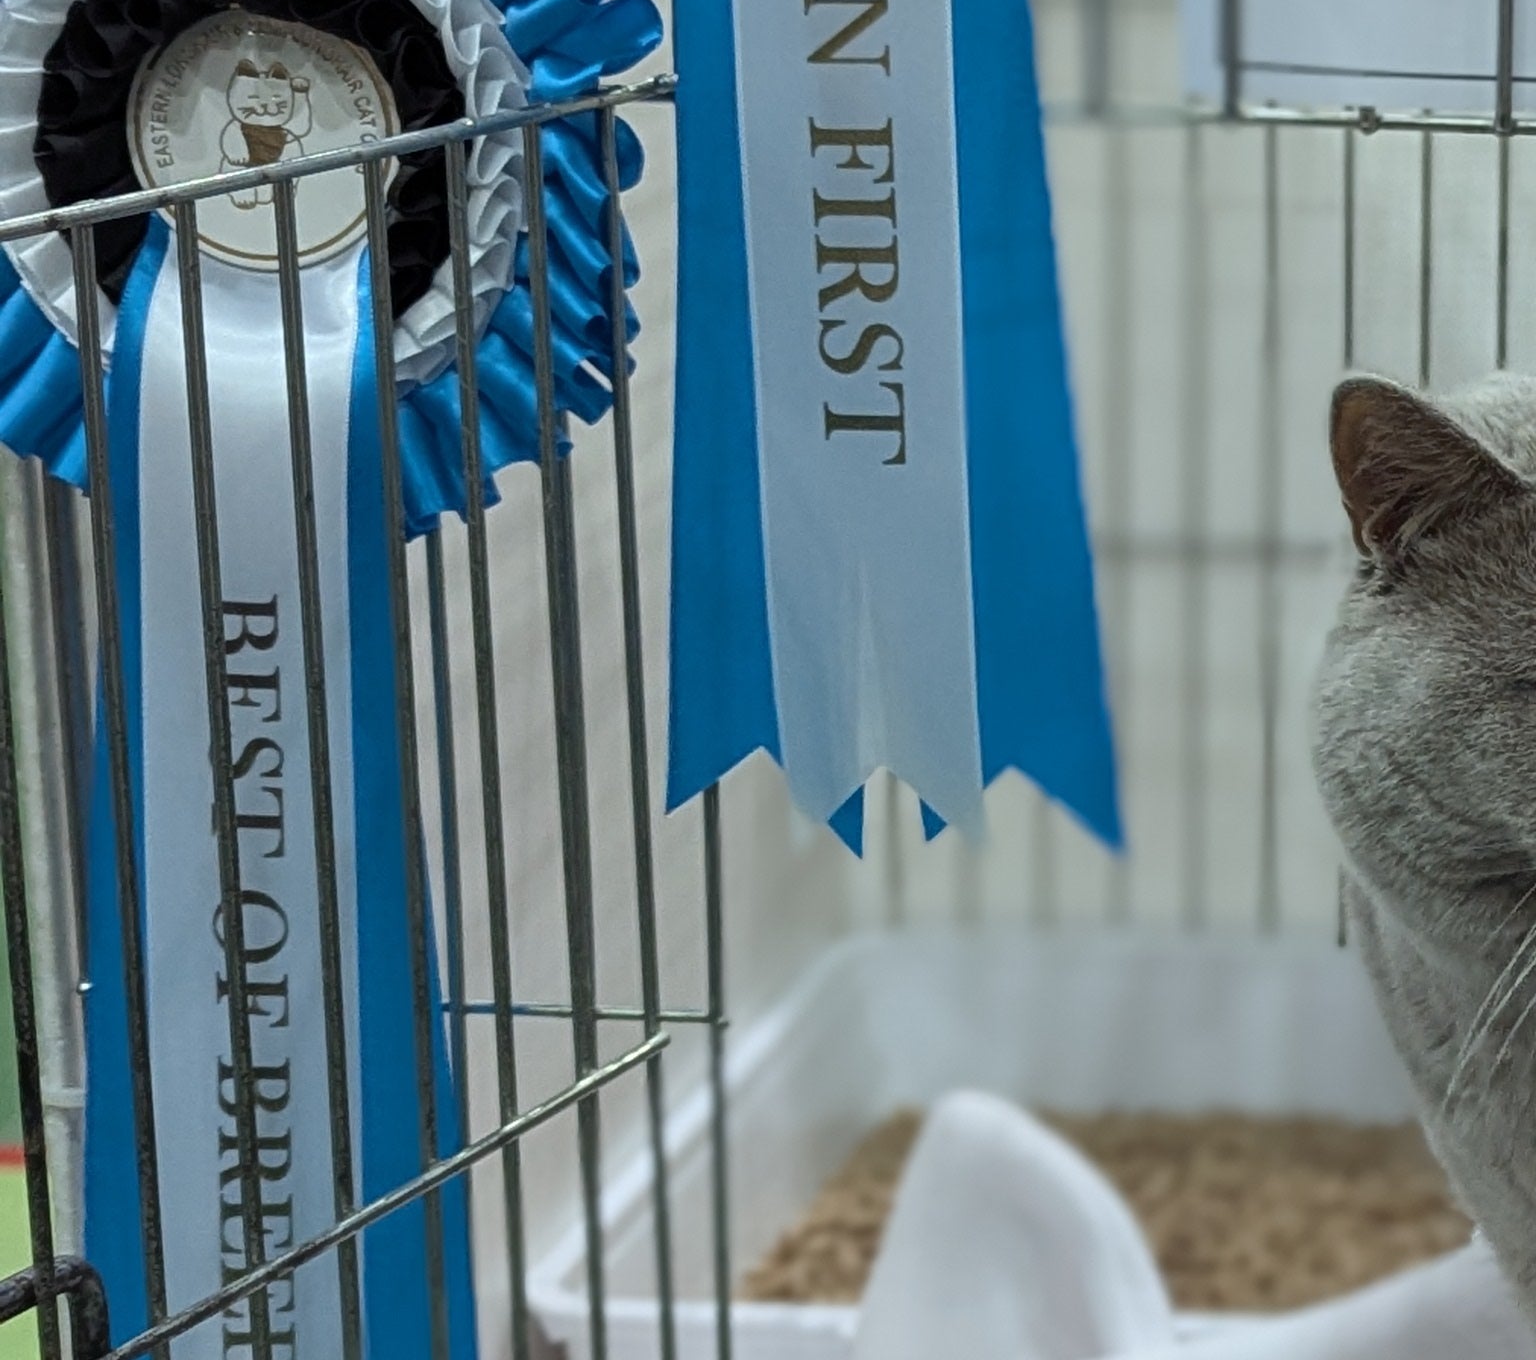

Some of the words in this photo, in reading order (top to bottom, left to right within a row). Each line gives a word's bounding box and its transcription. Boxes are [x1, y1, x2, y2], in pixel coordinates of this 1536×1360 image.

[150, 89, 175, 169] EASTERN
[353, 97, 377, 128] CAT
[808, 115, 908, 466] FIRST
[212, 887, 291, 1030] OF
